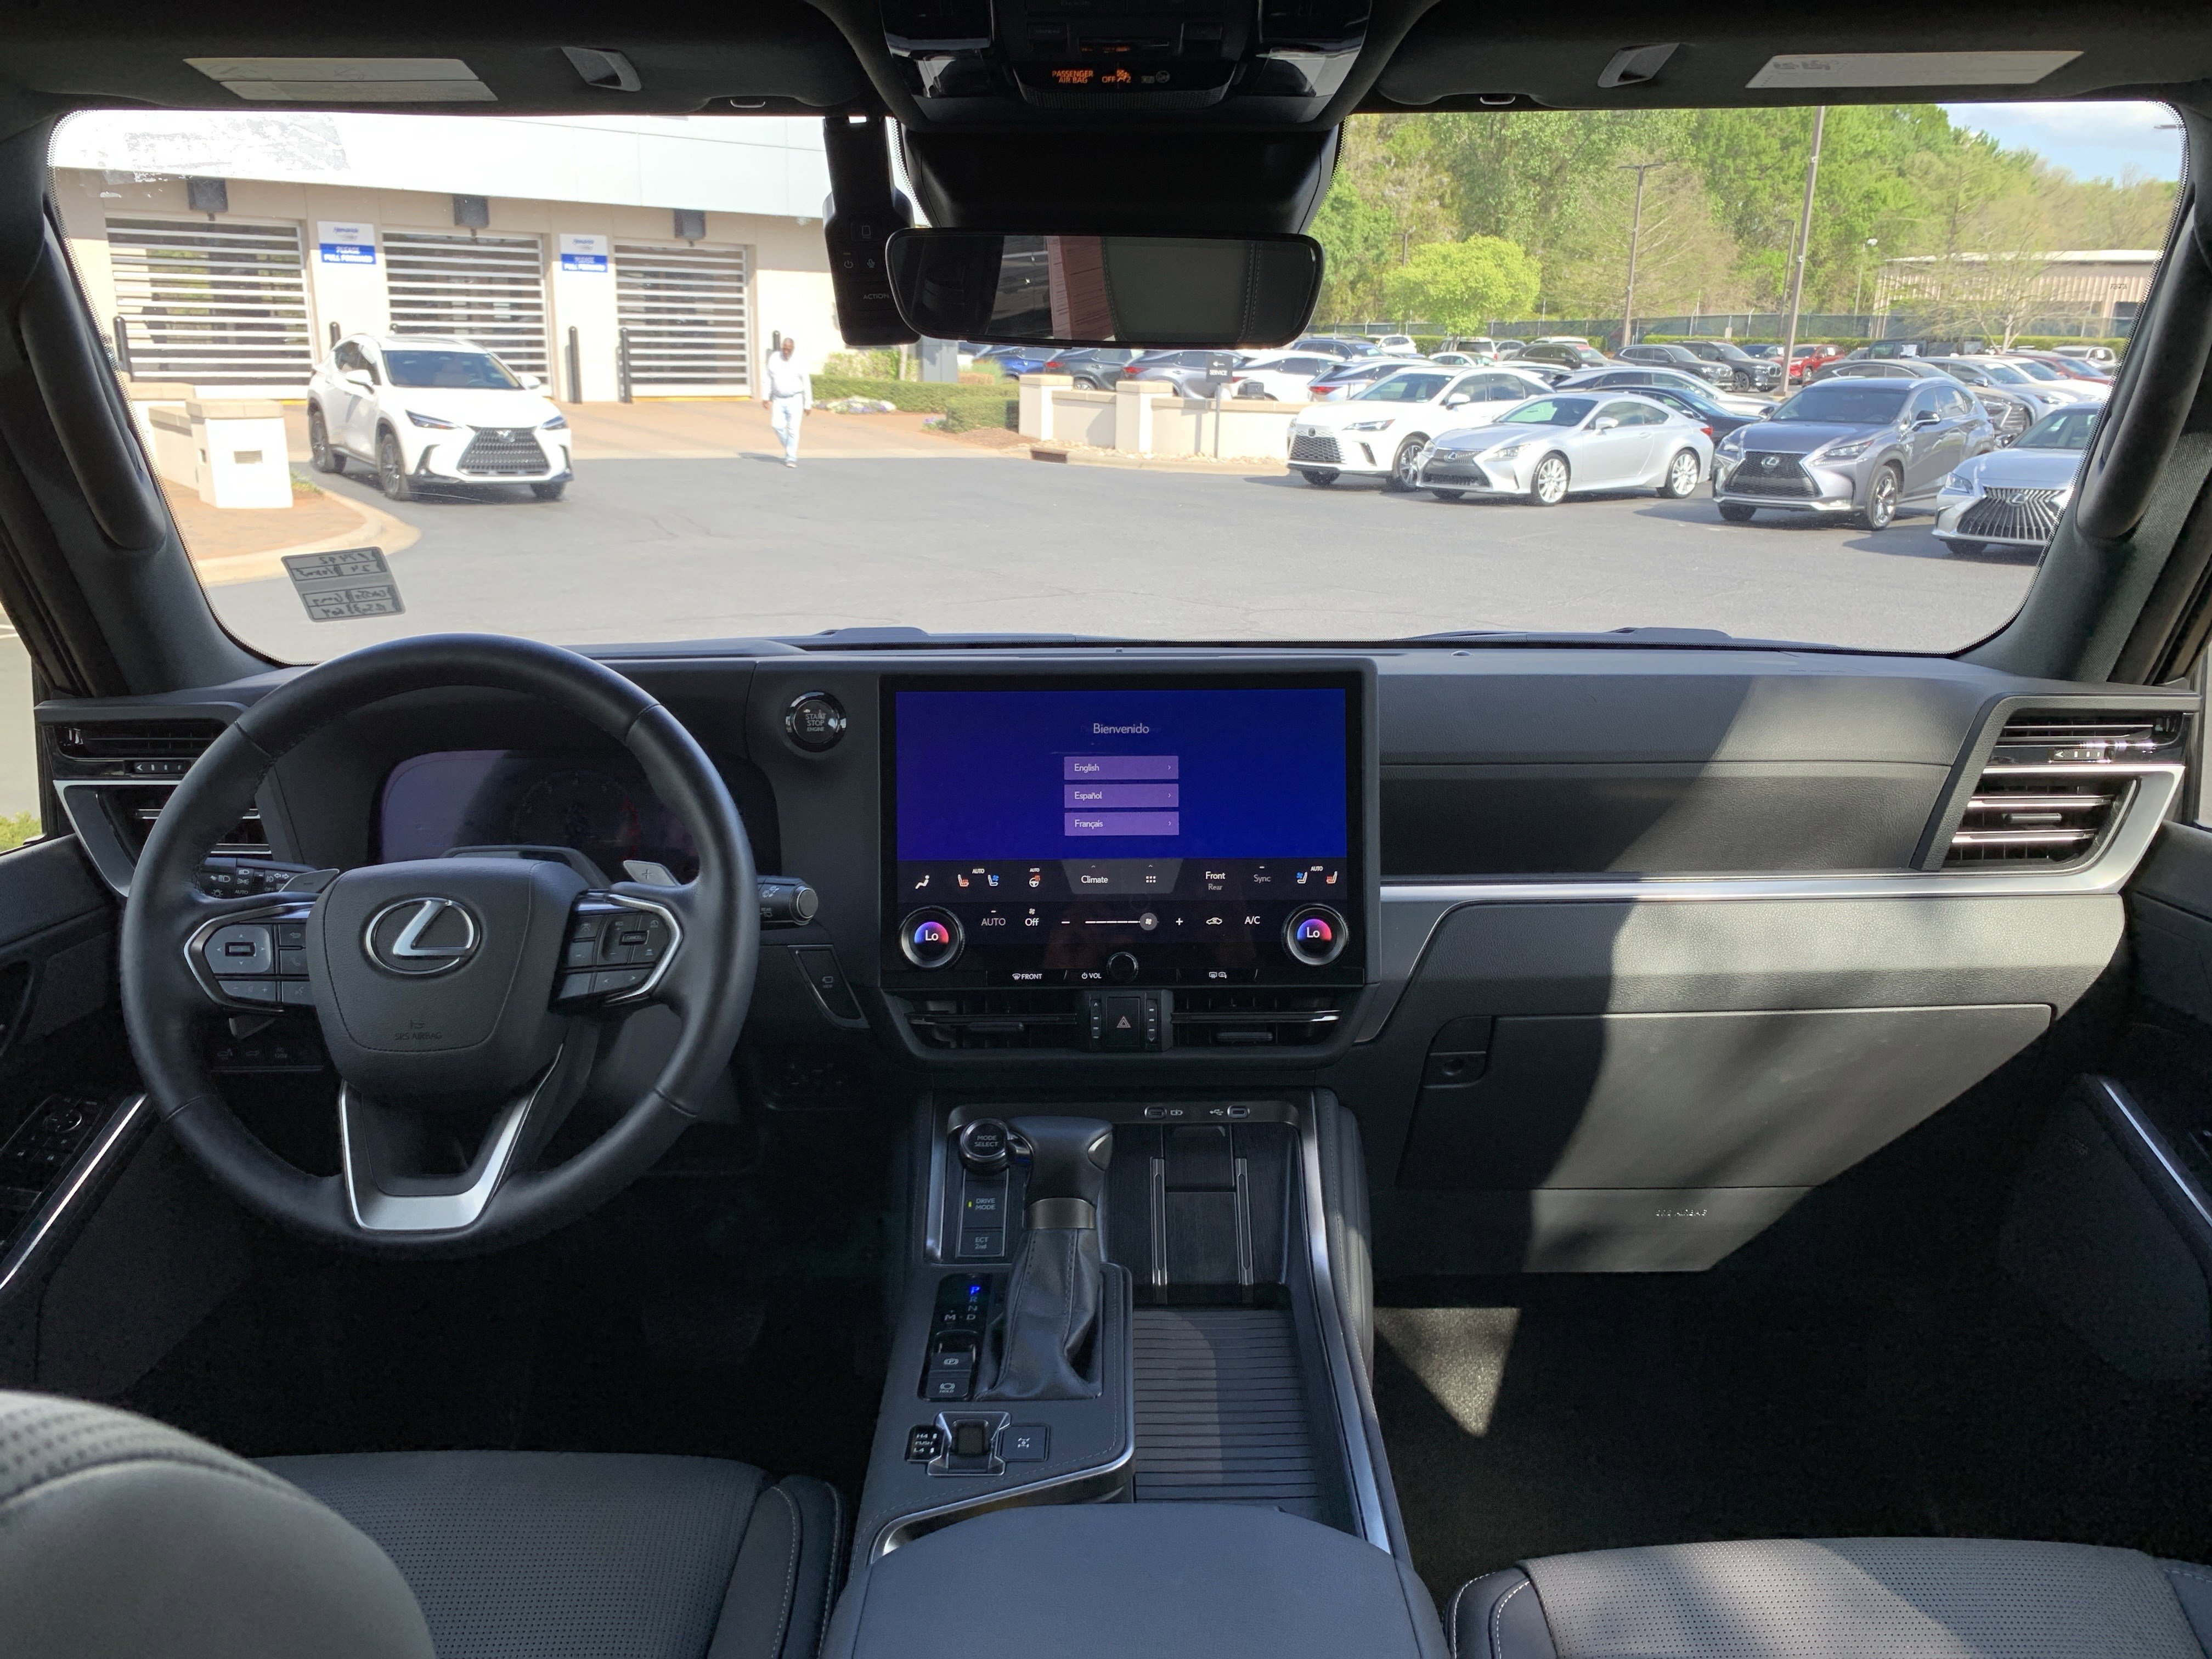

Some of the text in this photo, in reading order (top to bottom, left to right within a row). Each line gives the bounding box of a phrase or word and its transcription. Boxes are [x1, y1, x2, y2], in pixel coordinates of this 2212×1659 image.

[1093, 723, 1149, 733] Bienvenido
[1074, 763, 1099, 773] English
[1074, 791, 1102, 801] Español
[1074, 820, 1103, 830] Français
[1205, 871, 1226, 879] Front
[1254, 874, 1271, 883] Sync
[1081, 876, 1108, 884] Climate
[1025, 918, 1039, 926] Off
[1245, 916, 1261, 924] A/C
[925, 930, 938, 941] Lo
[1306, 927, 1320, 938] Lo
[970, 1286, 981, 1295] P
